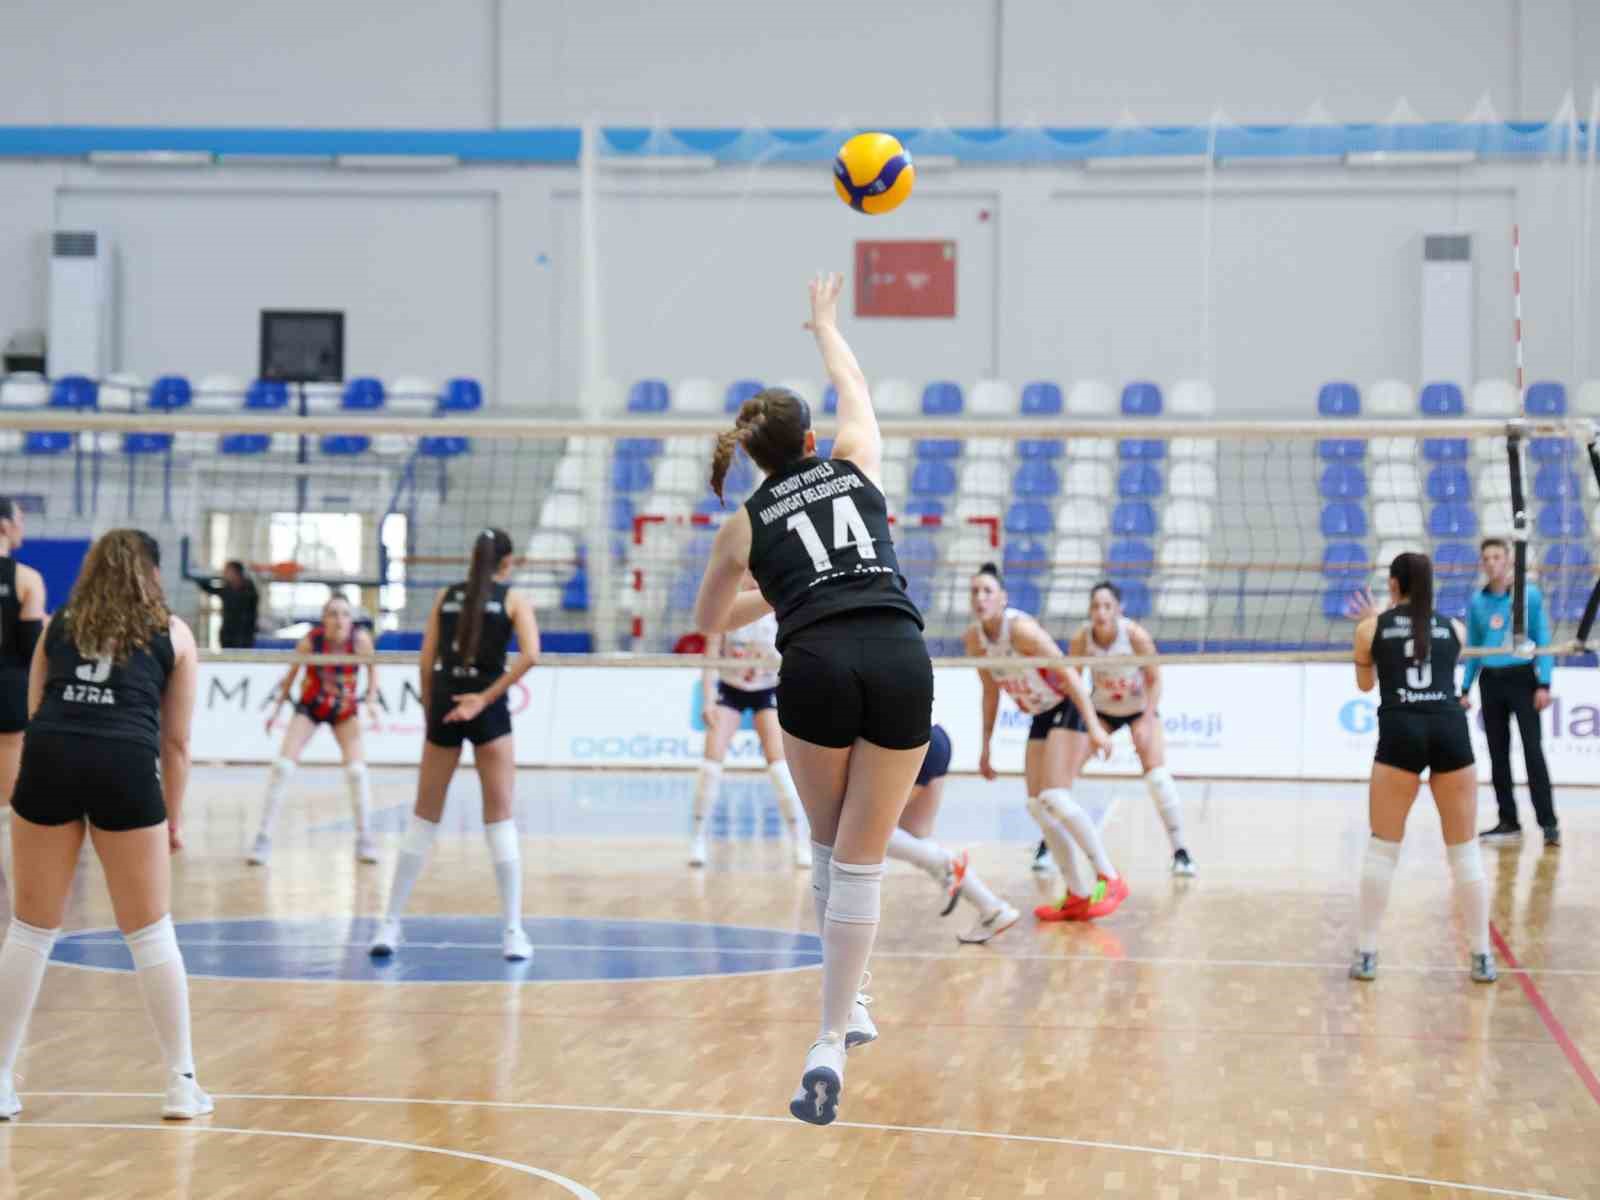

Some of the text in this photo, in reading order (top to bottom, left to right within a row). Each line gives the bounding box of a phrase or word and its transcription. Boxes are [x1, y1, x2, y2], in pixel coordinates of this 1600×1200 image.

[769, 462, 835, 499] TRENDY HOTELS
[786, 496, 877, 573] 14
[62, 684, 115, 705] AZRA
